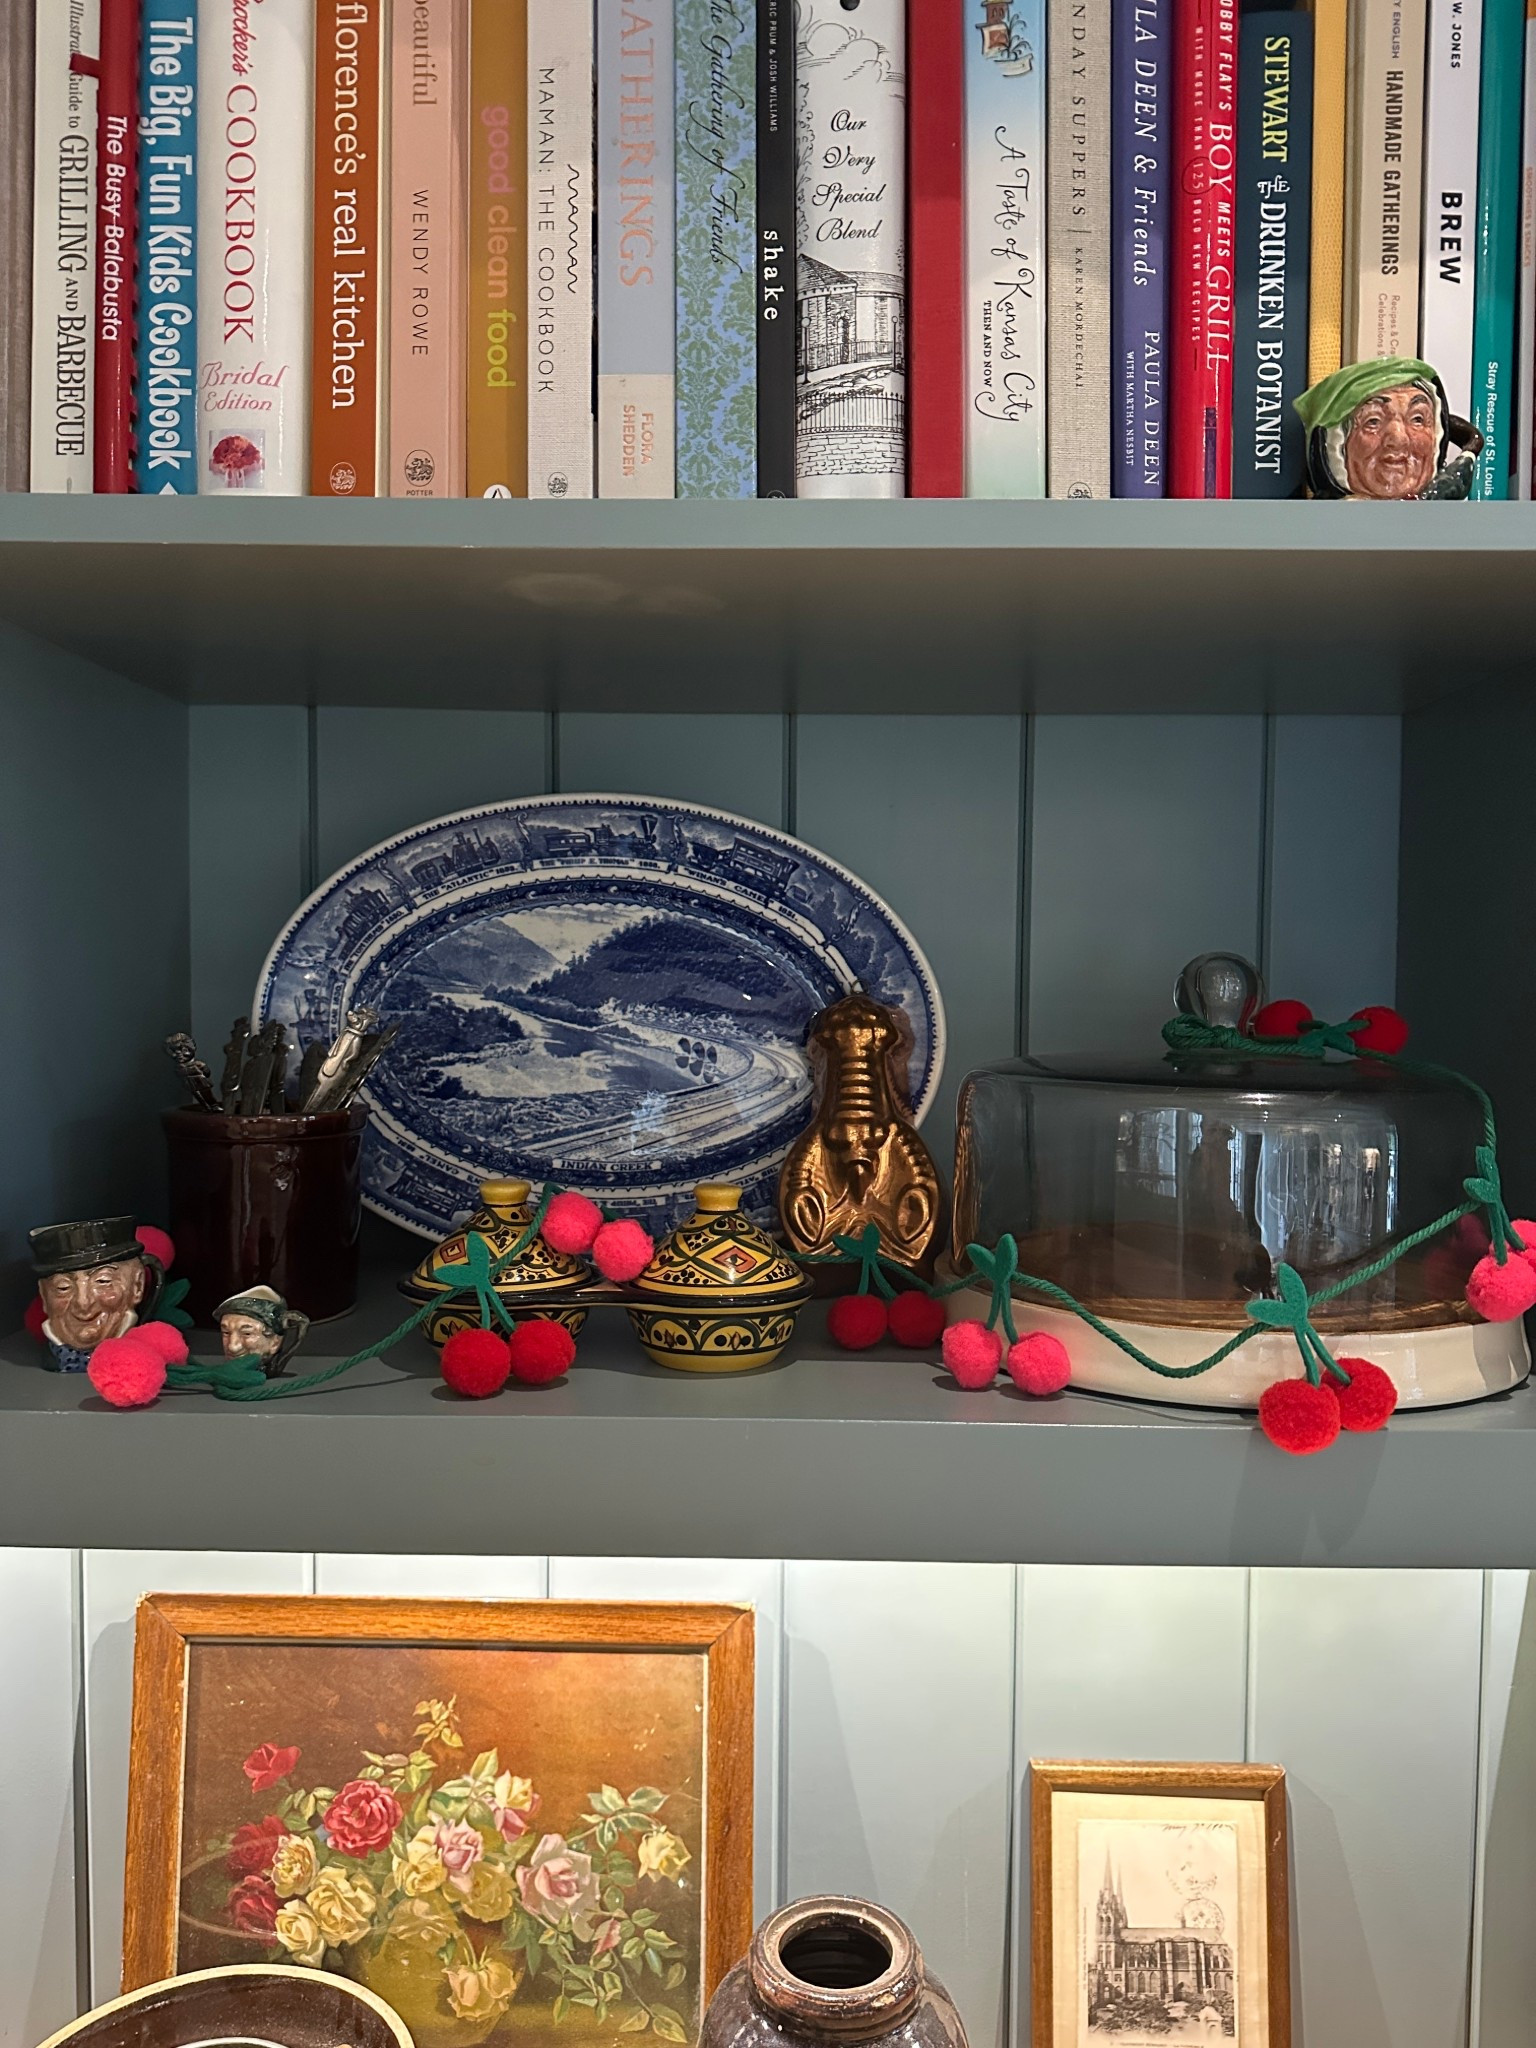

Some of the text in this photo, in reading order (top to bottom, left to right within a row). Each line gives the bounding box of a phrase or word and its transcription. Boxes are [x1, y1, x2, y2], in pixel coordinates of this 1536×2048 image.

[769, 0, 777, 17] RIC
[1392, 12, 1401, 58] ENGLISH
[1450, 1, 1462, 69] W. JONES
[769, 59, 777, 82] JOSH
[769, 86, 777, 132] WILLIAMS
[1071, 4, 1086, 216] NDAY SUPPERS
[1134, 58, 1156, 142] DEEN
[1262, 36, 1290, 162] STEWART
[620, 0, 654, 287] ATHERINGS
[686, 0, 745, 275] The Gathering of Friends
[822, 146, 876, 174] Very
[830, 109, 866, 132] Our
[1135, 154, 1156, 174] &
[224, 0, 265, 344] rocker's COOKBOOK
[332, 2, 368, 408] florence's real kitchen
[812, 182, 886, 212] Special
[1191, 26, 1204, 341] WITH MORE THAN 125 BOLD NEW RECIPES
[1206, 0, 1234, 370] OBBY FLAY'S BOY MEETS GRILL
[1380, 70, 1403, 275] HANDMADE GATHERINGS
[55, 0, 89, 456] Illustrat Guide to GRILLING AND BARBECUE
[100, 116, 127, 341] The Busy Balabusta
[136, 17, 193, 469] The Big, Fun Kids Cookbook
[412, 190, 428, 354] WENDY ROWE
[481, 106, 516, 387] good clean food
[537, 68, 554, 392] MAMAN: THE COOKBOOK
[816, 218, 882, 242] Blend
[975, 126, 1036, 422] A Taste of Kansas City
[1133, 187, 1156, 286] Friends
[1439, 192, 1463, 284] BREW
[763, 230, 783, 320] shake
[1074, 248, 1084, 388] KAREN MORDECHAI
[1377, 293, 1388, 348] Celebrations
[1389, 295, 1400, 328] Recipes
[983, 301, 992, 386] THEN AND NOW
[1254, 174, 1290, 474] THE DRUNKEN BOTANIST
[1390, 339, 1399, 354] Cra
[200, 361, 290, 390] Bridal
[204, 390, 272, 412] Edition
[1125, 351, 1134, 466] WITH MARTHA NESBIT
[1142, 331, 1160, 486] PAULA DEEN
[622, 405, 635, 476] SHEDDEN
[640, 413, 654, 464] FLORA
[1484, 361, 1498, 496] Stray Rescue of St. Louis
[422, 888, 440, 900] THE
[561, 1160, 652, 1171] INDIAN CREEK
